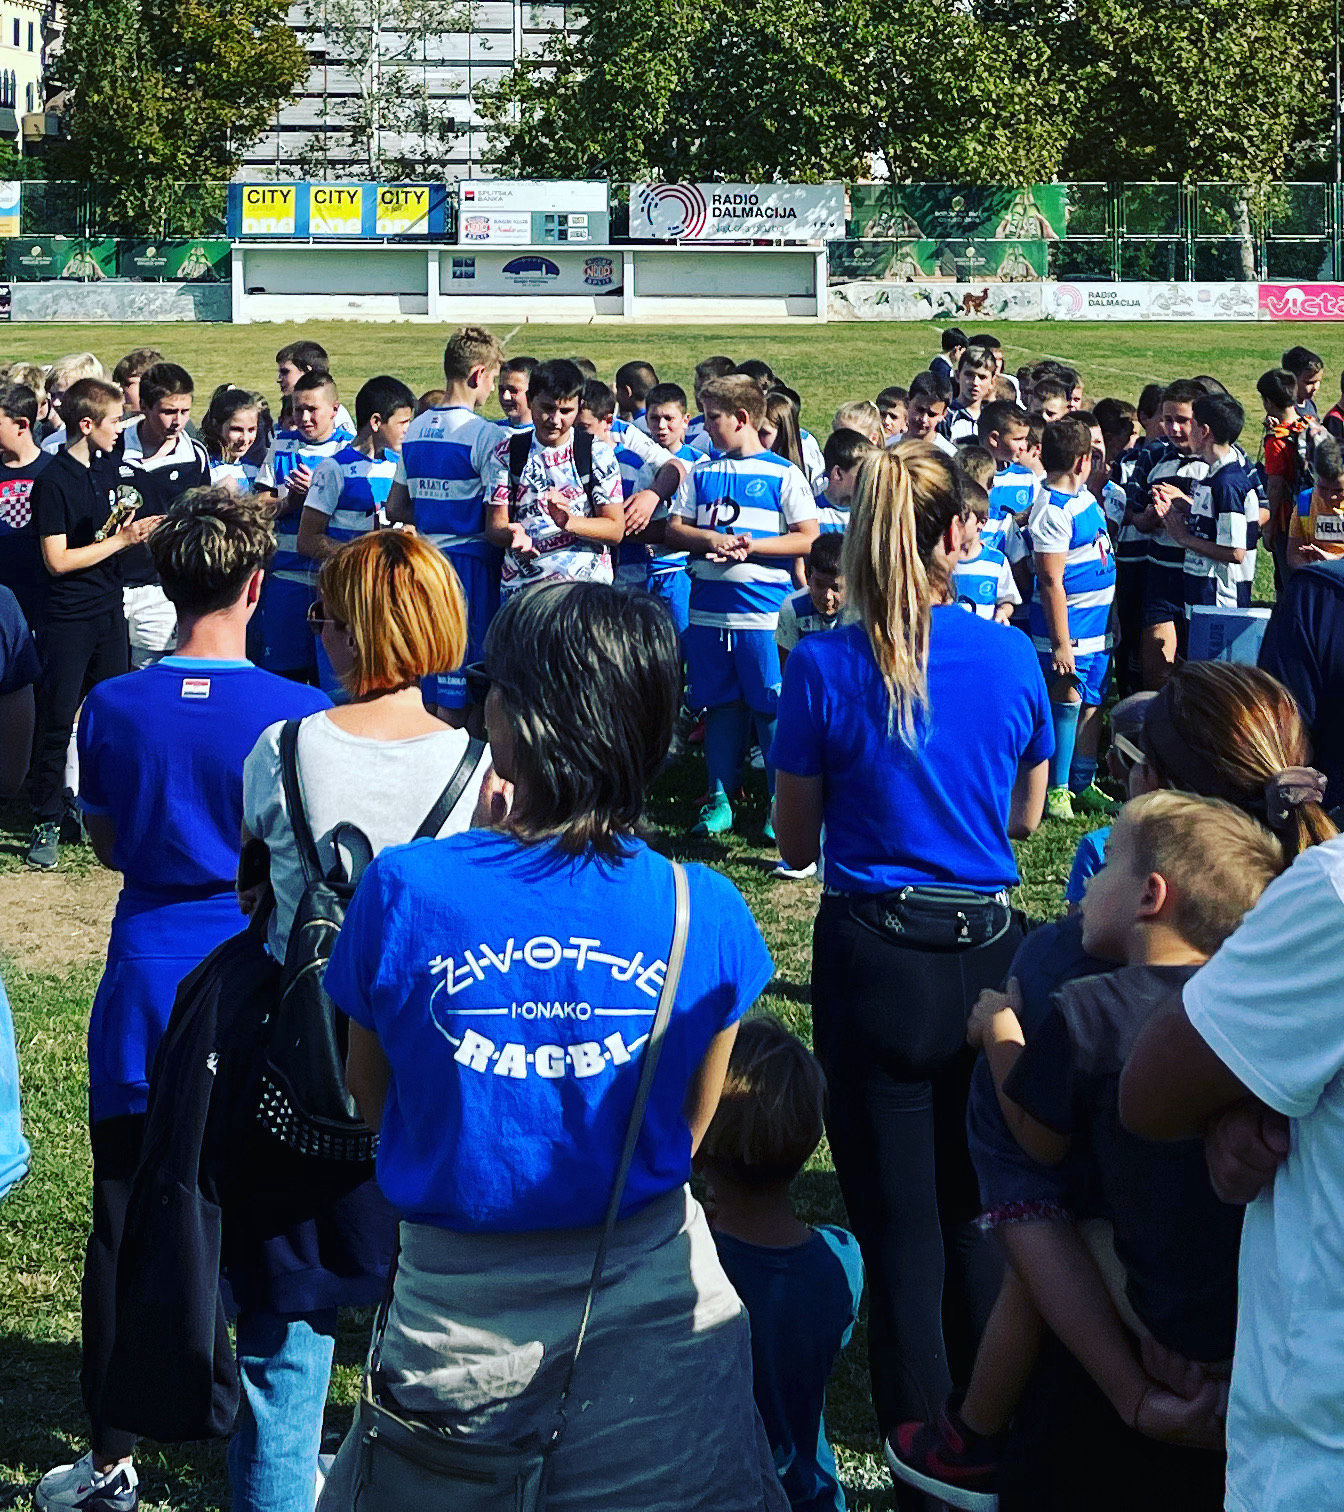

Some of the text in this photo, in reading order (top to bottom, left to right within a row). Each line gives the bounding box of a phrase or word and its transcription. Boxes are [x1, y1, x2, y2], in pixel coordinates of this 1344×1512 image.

[247, 189, 292, 204] CITY
[314, 189, 359, 204] CITY
[381, 190, 425, 204] CITY
[712, 194, 759, 206] RADIO
[712, 206, 798, 219] DALMACIJA
[1088, 291, 1118, 299] RADIO
[1088, 299, 1141, 307] DALMACIJA
[428, 936, 601, 995] ŽIVOT
